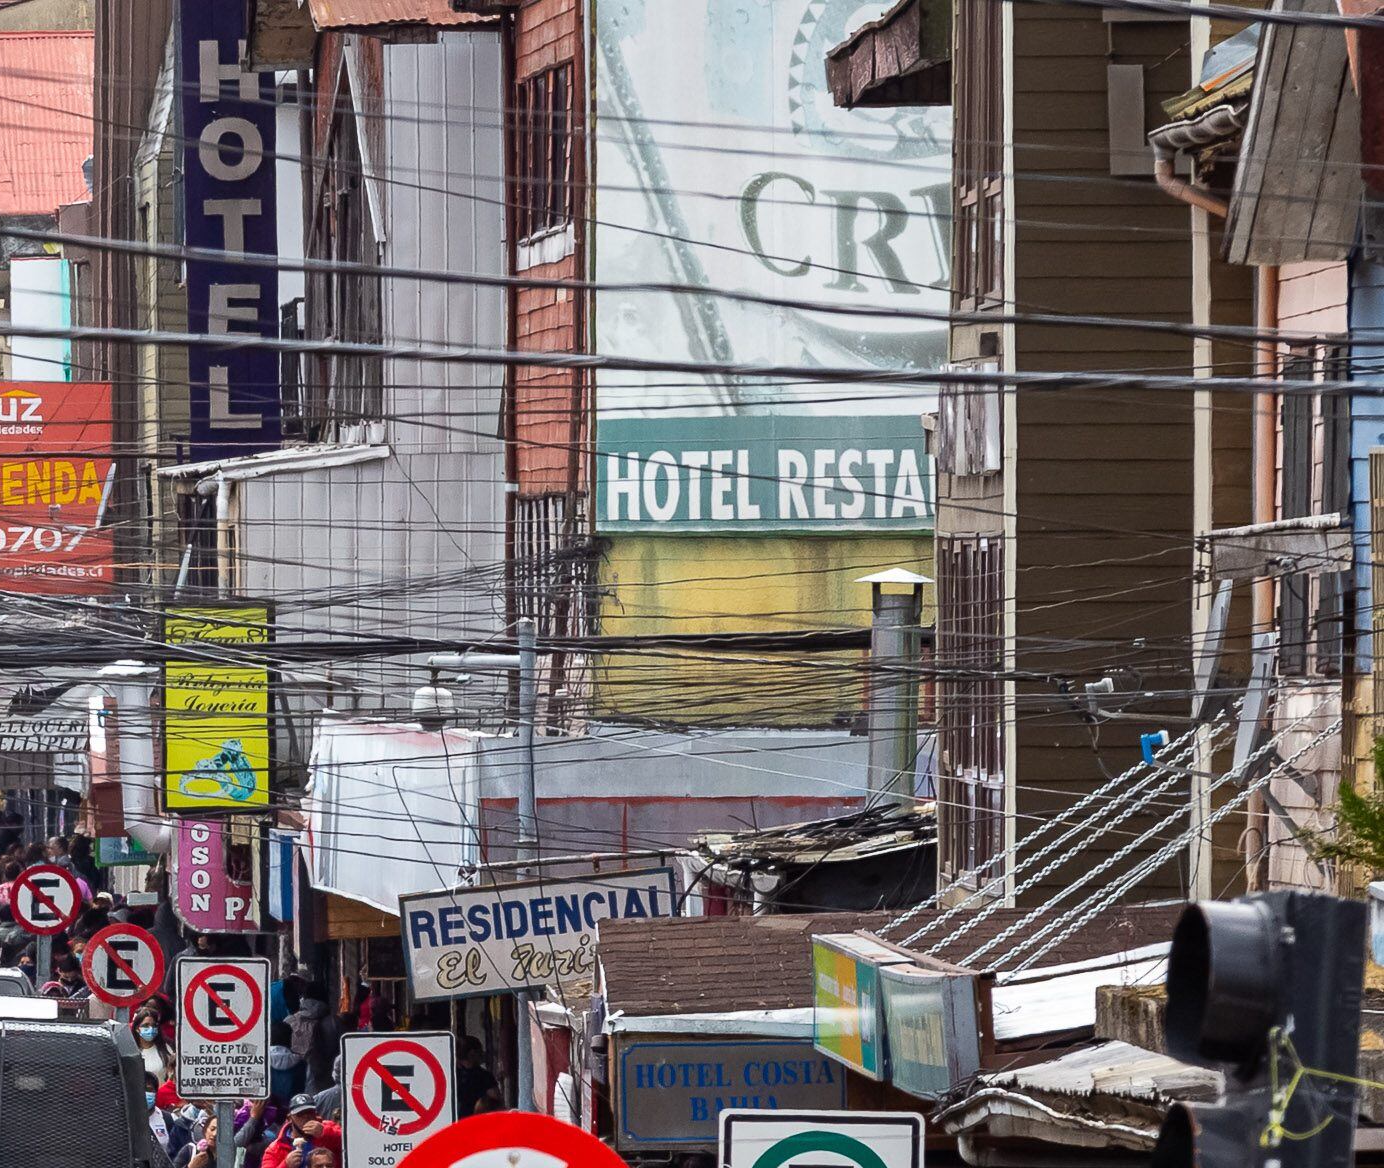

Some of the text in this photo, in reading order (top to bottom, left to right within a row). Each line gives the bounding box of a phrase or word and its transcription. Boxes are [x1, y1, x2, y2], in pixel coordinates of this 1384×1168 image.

[197, 39, 262, 431] HOTEL
[605, 448, 936, 524] HOTEL RESTA
[409, 885, 671, 949] RESIDENCIAL
[435, 946, 488, 990] El
[182, 1055, 265, 1065] VEHICULO FUERZAS
[199, 1044, 249, 1054] EXCEPTO
[194, 1066, 252, 1076] ESPECIALES
[635, 1059, 835, 1089] HOTEL COSTA
[368, 1156, 396, 1166] SOLO
